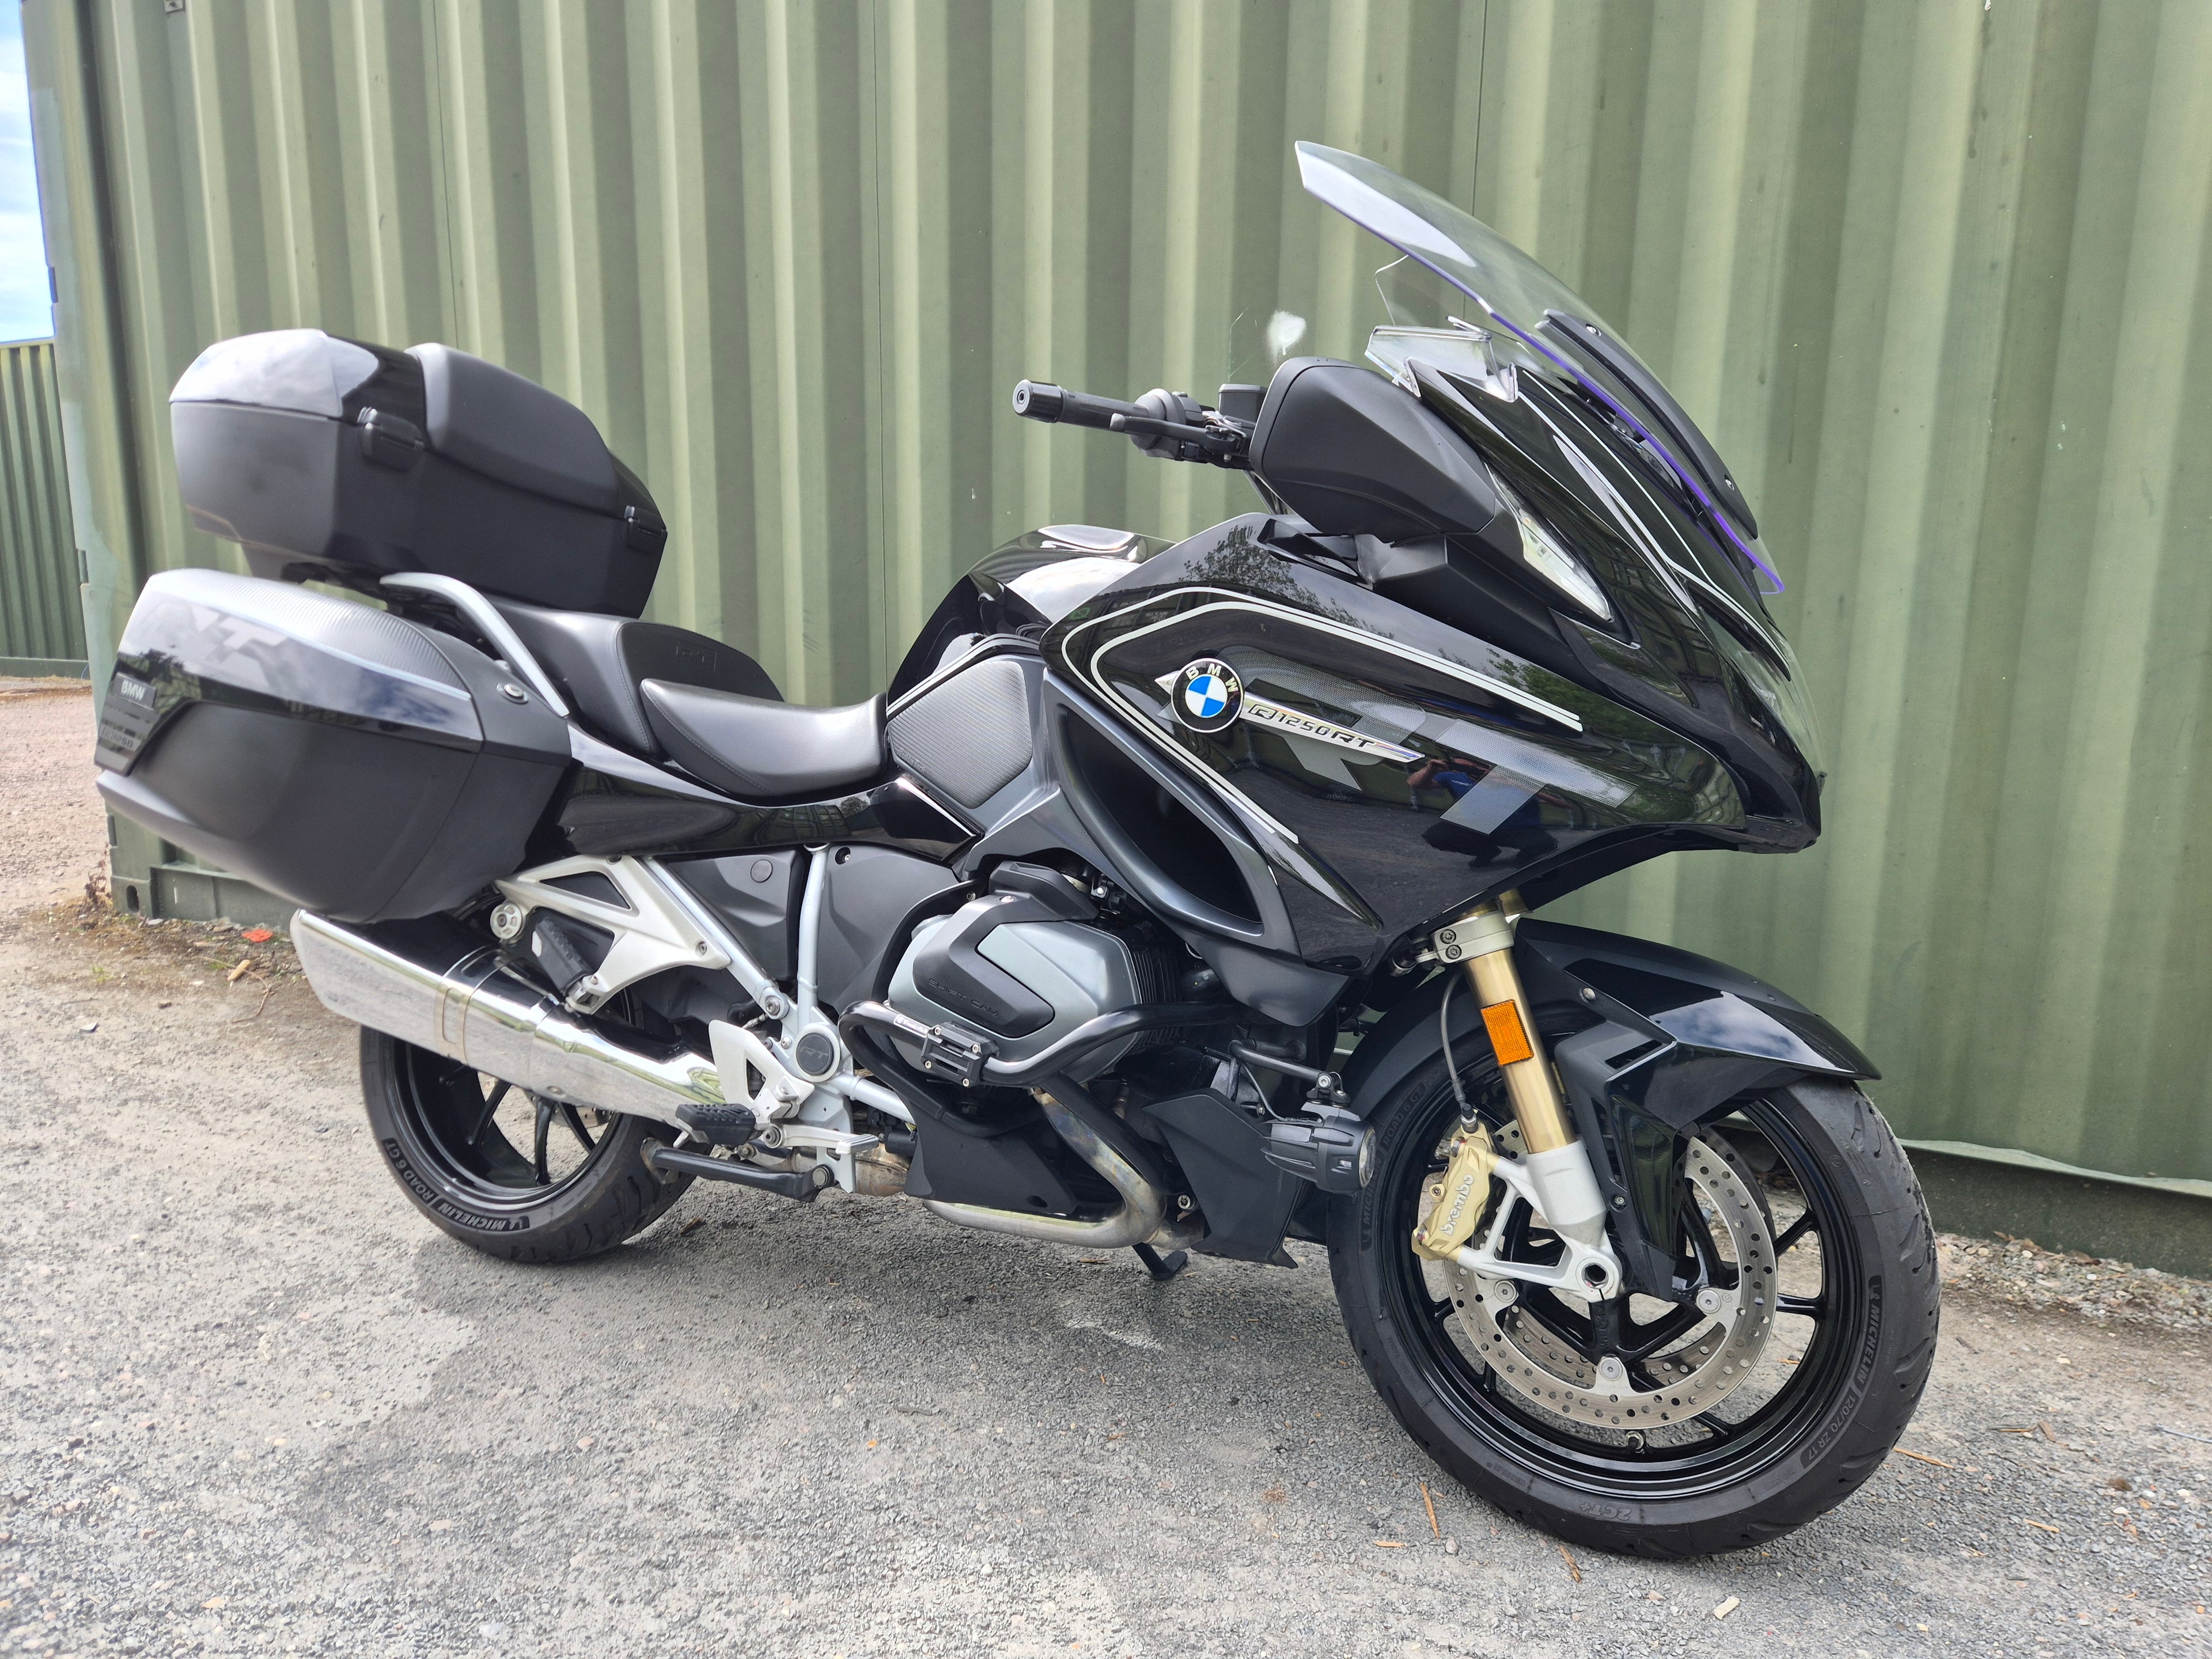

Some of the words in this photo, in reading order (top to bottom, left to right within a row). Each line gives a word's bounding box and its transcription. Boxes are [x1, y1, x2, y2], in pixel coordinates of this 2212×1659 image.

[120, 680, 146, 700] BMW
[1185, 662, 1239, 694] BMW
[927, 977, 968, 1001] SHIFT
[970, 998, 999, 1017] CAM
[799, 1046, 830, 1059] RT
[1383, 1112, 1404, 1147] ROAD
[1403, 1101, 1411, 1112] 6
[385, 1142, 400, 1158] GT
[395, 1159, 407, 1169] 6
[403, 1169, 434, 1201] ROAD
[437, 1202, 507, 1230] MICHELIN
[1440, 1174, 1475, 1236] brembo
[1857, 1303, 1881, 1385] MICHELIN
[1831, 1395, 1855, 1433] 120/70
[1809, 1446, 1819, 1460] 17
[1817, 1431, 1831, 1449] ZR
[1579, 1501, 1632, 1521] 2CT+
